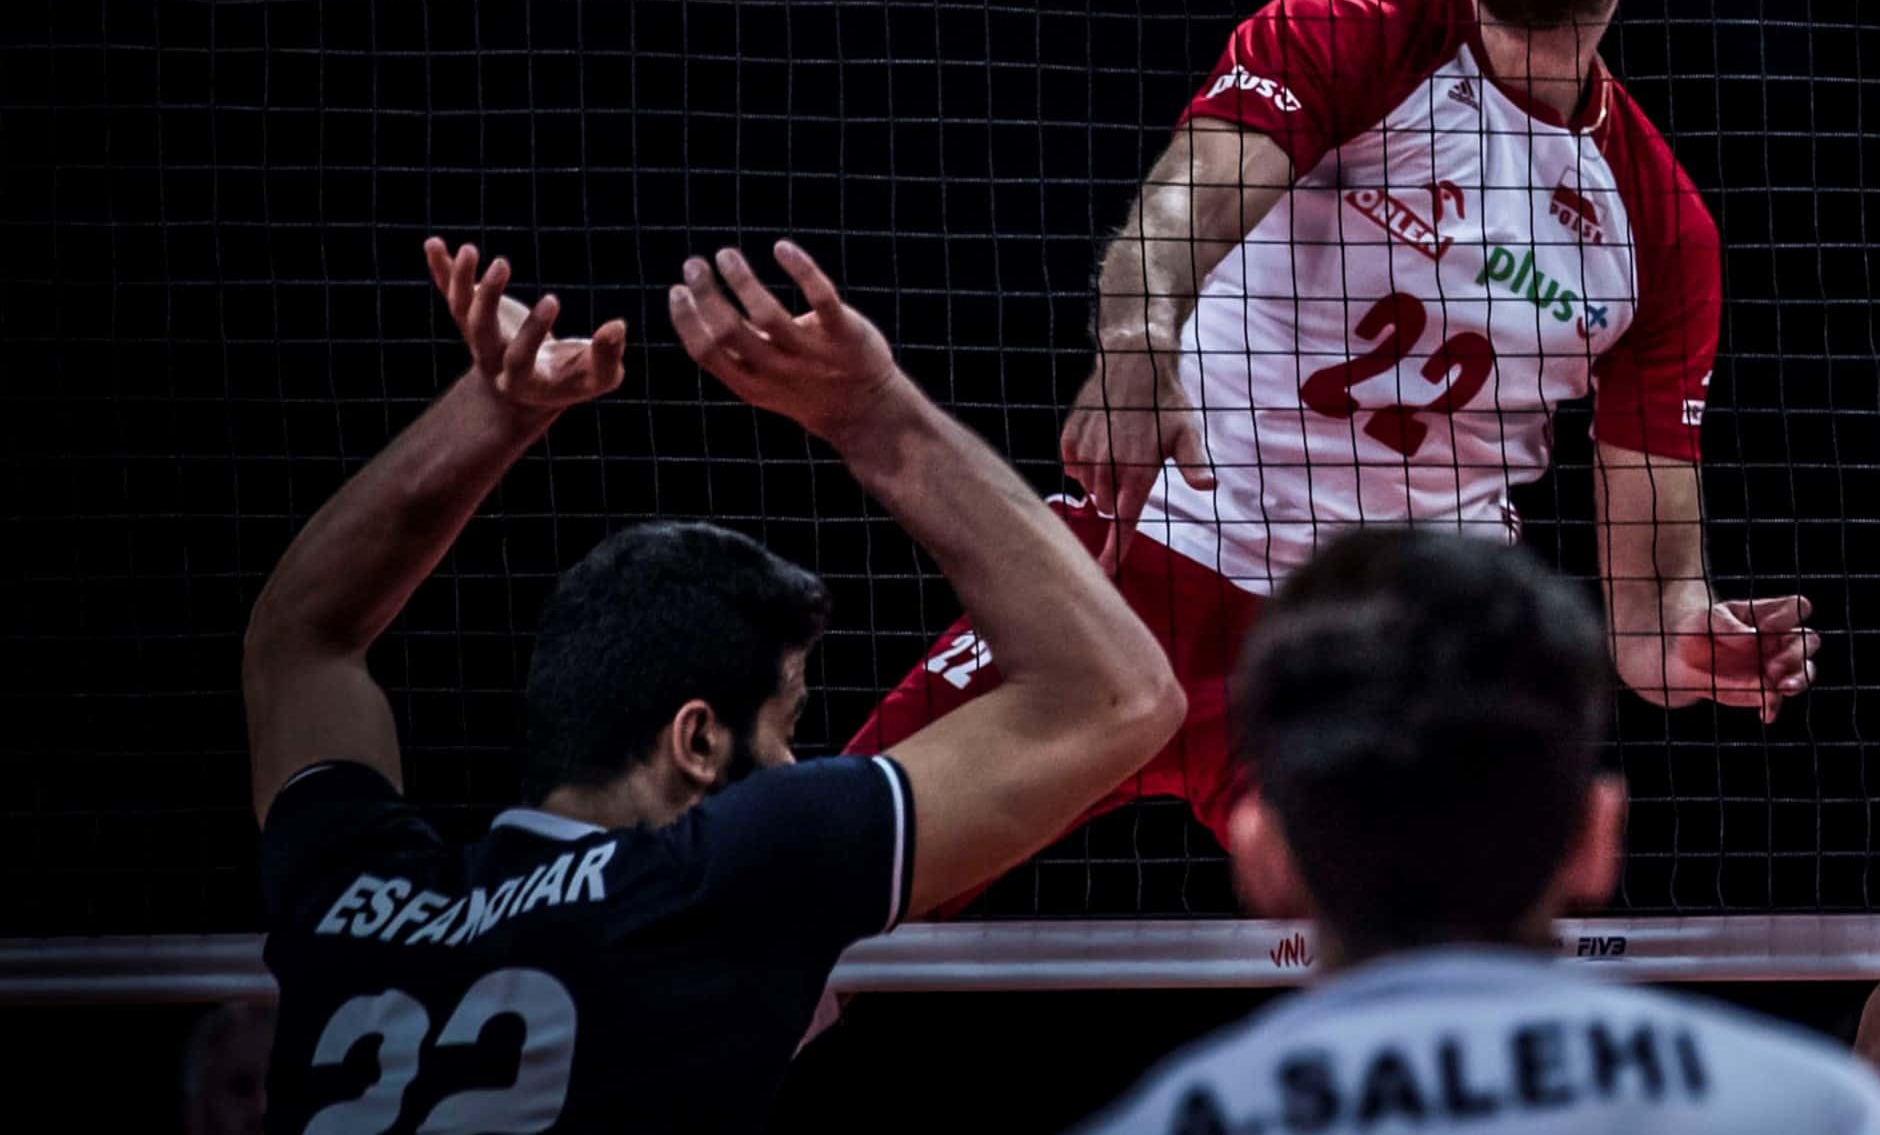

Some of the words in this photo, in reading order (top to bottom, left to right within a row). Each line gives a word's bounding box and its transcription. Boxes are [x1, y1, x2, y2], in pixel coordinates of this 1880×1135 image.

[1475, 246, 1579, 322] plus
[1300, 293, 1495, 456] 22
[1269, 932, 1315, 967] VNL
[303, 966, 578, 1135] 22
